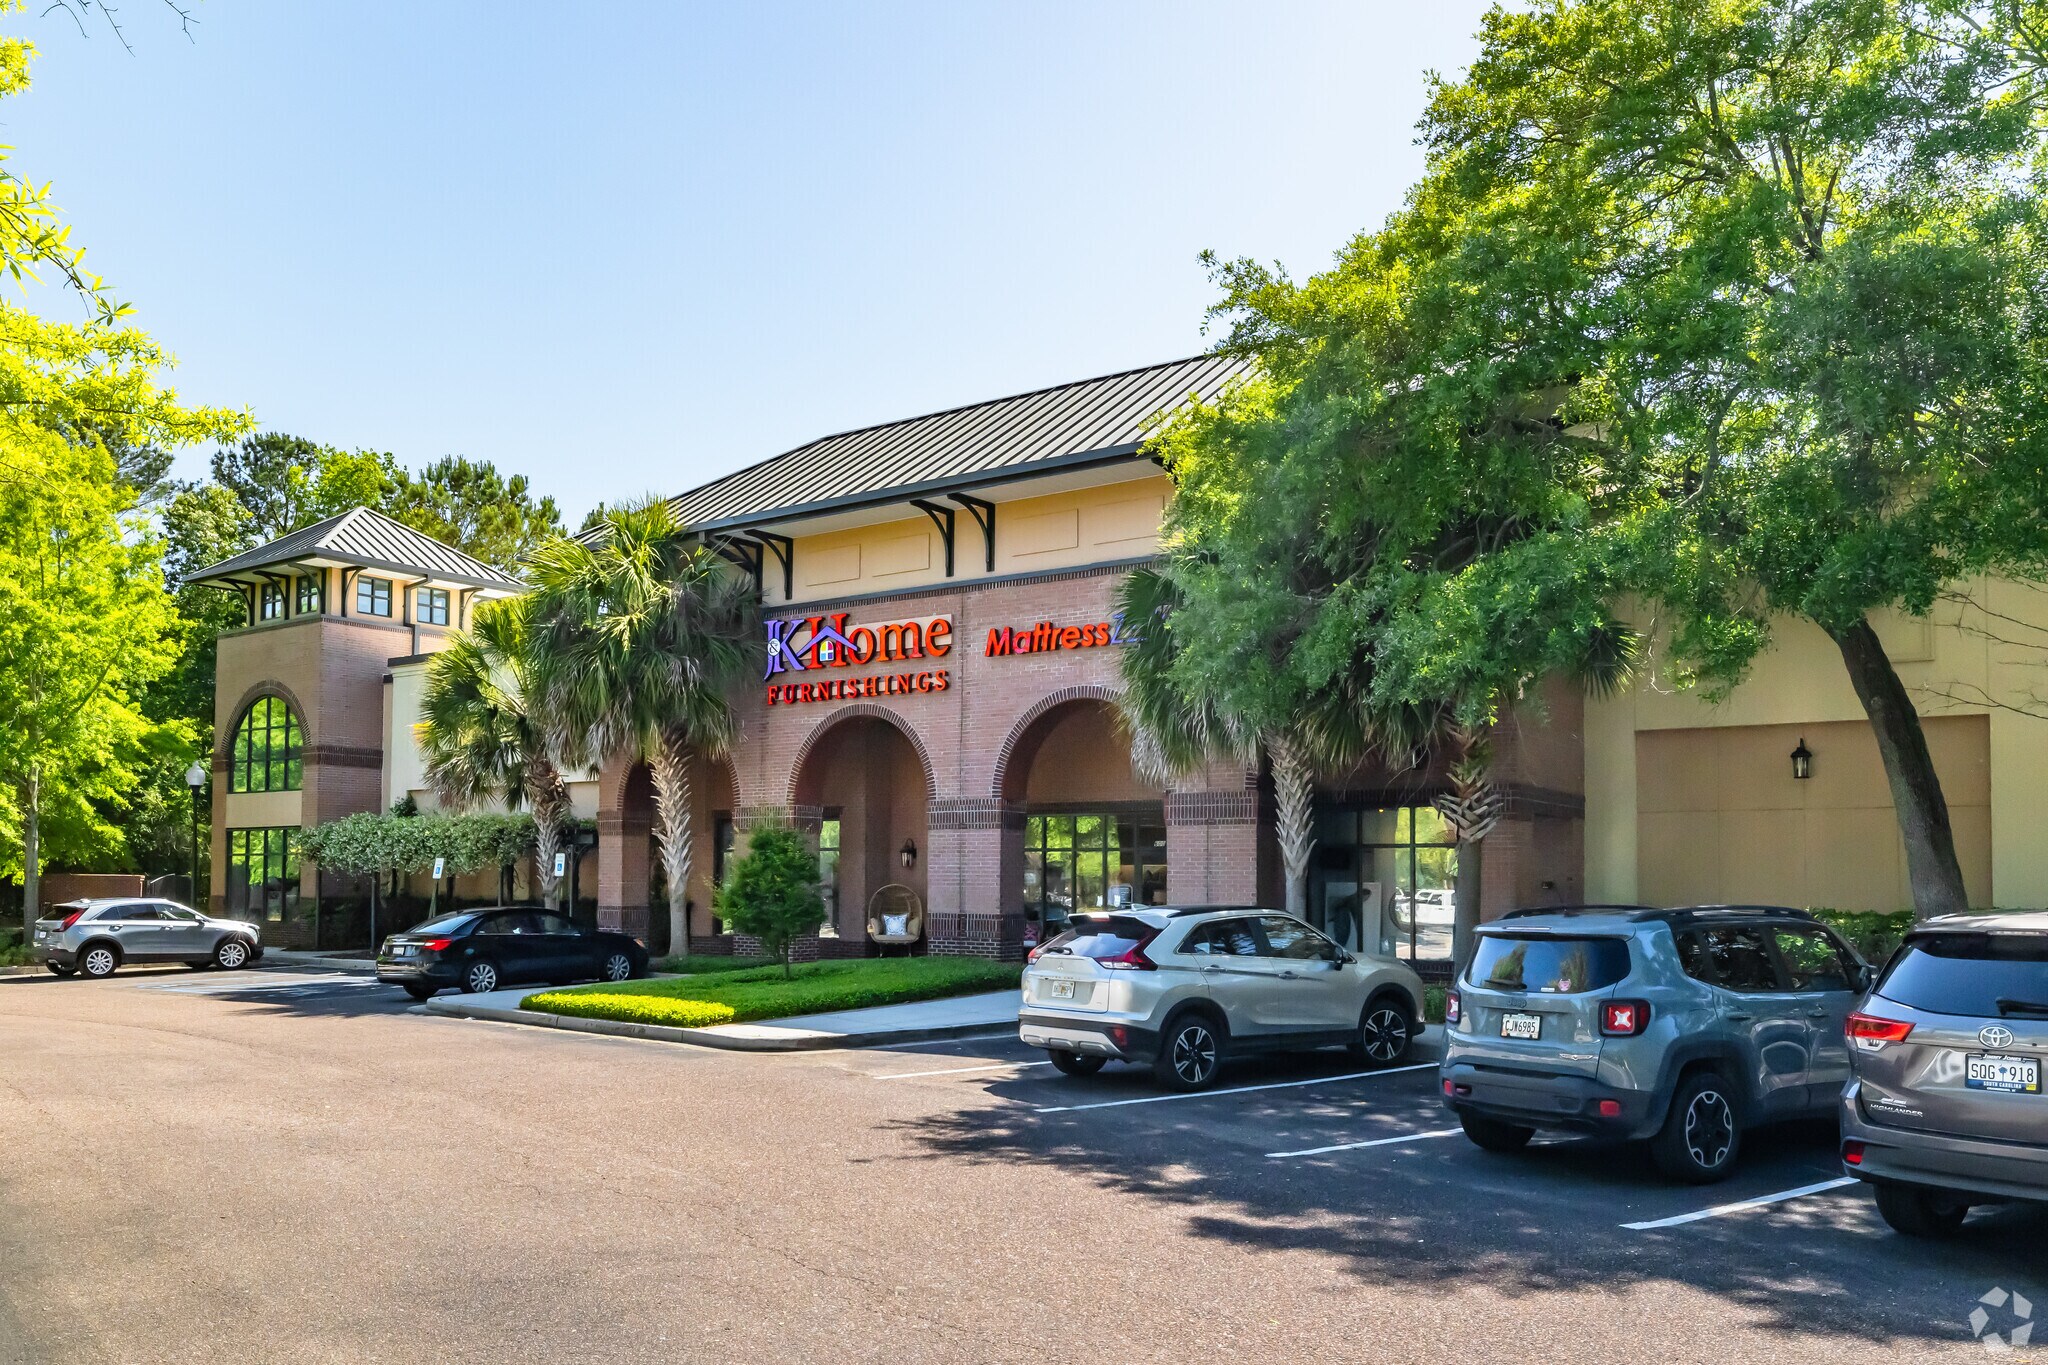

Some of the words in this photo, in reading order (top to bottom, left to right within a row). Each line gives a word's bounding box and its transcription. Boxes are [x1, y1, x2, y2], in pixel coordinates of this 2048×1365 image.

[985, 621, 1110, 657] Mattress
[767, 669, 949, 705] FURNISHINGS
[1971, 1063, 1995, 1080] SQG
[2009, 1066, 2034, 1083] 918
